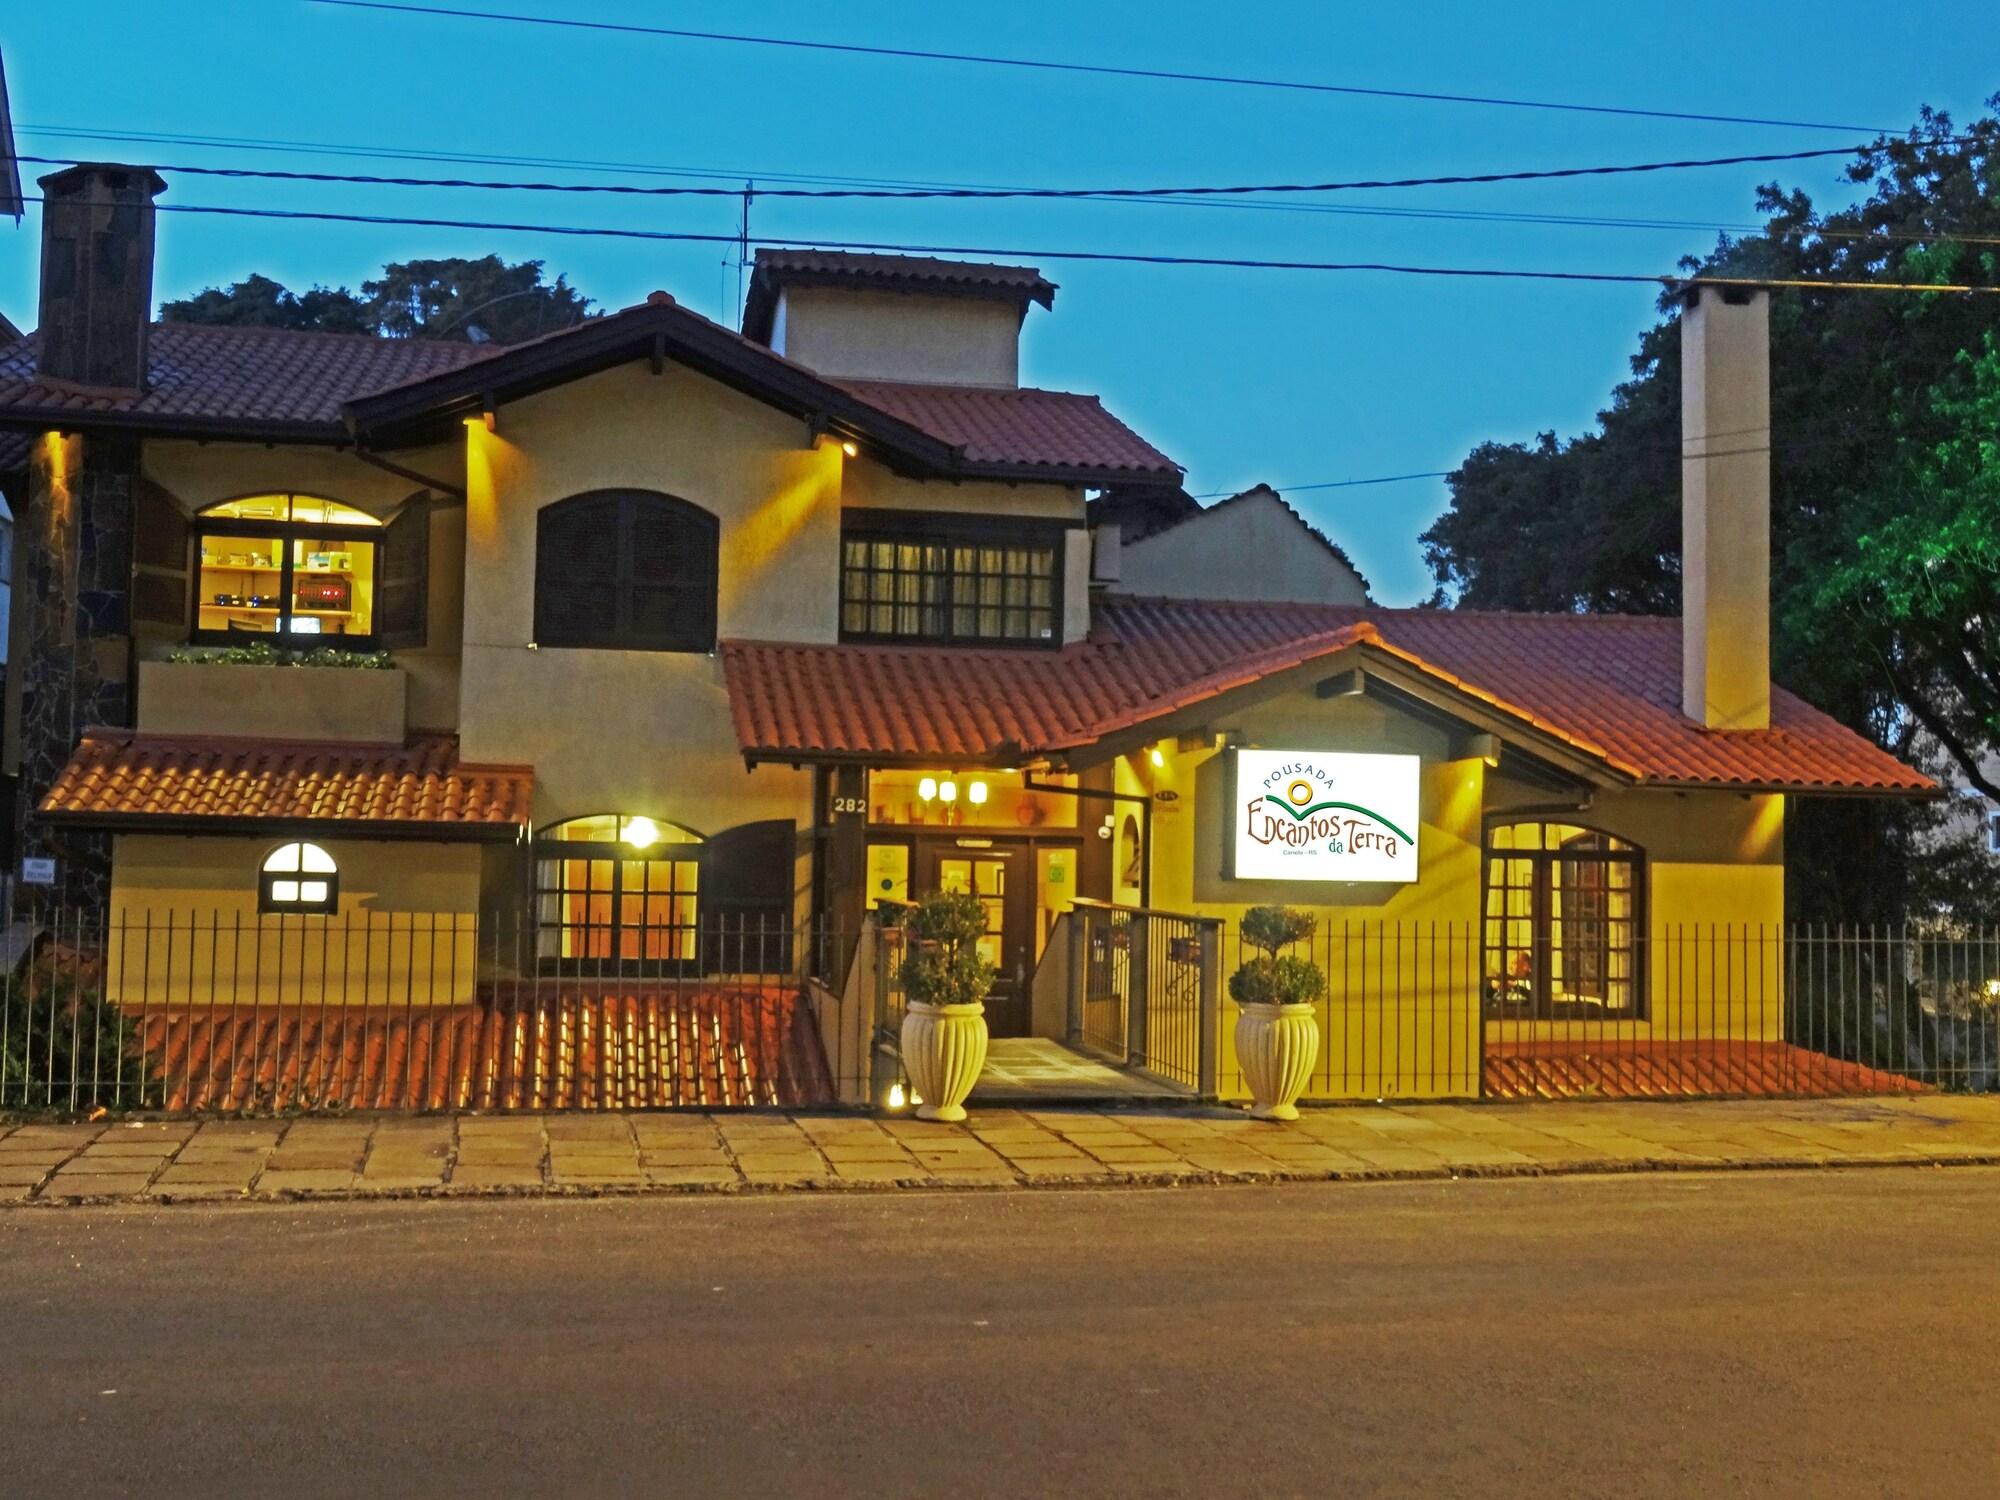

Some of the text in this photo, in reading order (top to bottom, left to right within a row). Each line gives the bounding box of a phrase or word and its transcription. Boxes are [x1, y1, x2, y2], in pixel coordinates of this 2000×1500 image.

[1263, 762, 1335, 790] POUSADA
[834, 798, 866, 813] 282
[1247, 796, 1397, 859] Encantos da Terra
